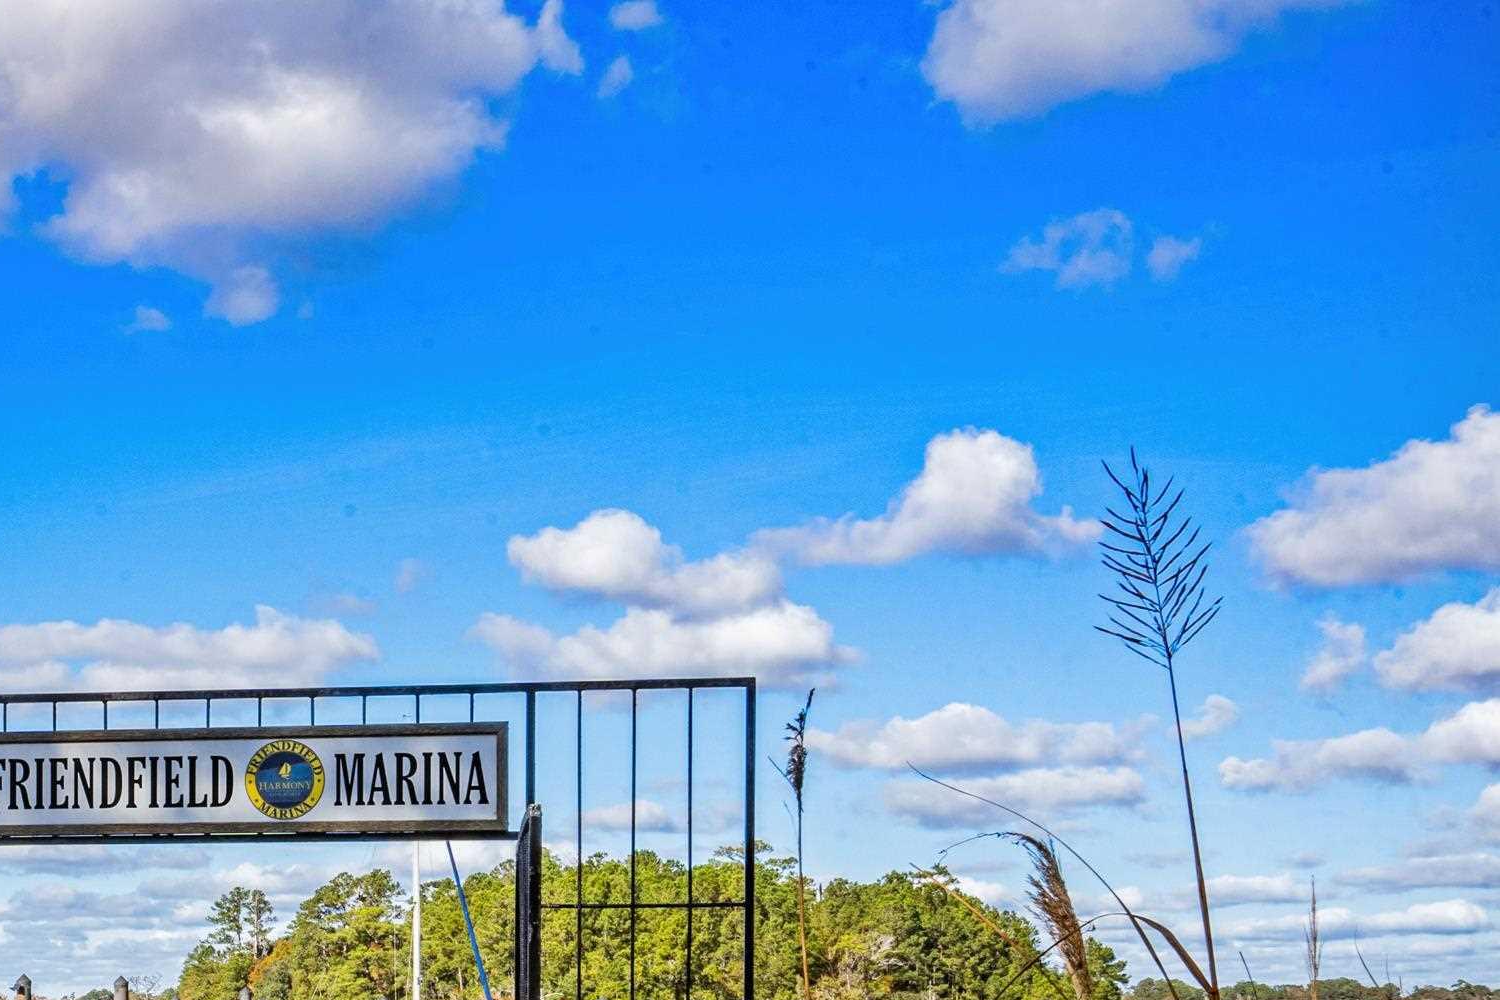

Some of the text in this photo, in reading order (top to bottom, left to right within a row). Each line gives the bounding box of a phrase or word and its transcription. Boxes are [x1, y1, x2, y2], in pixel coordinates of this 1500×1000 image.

[247, 740, 322, 775] FRIENDFIELD
[259, 781, 310, 790] HARMONY
[334, 751, 489, 805] MARINA
[260, 802, 312, 818] MARINA
